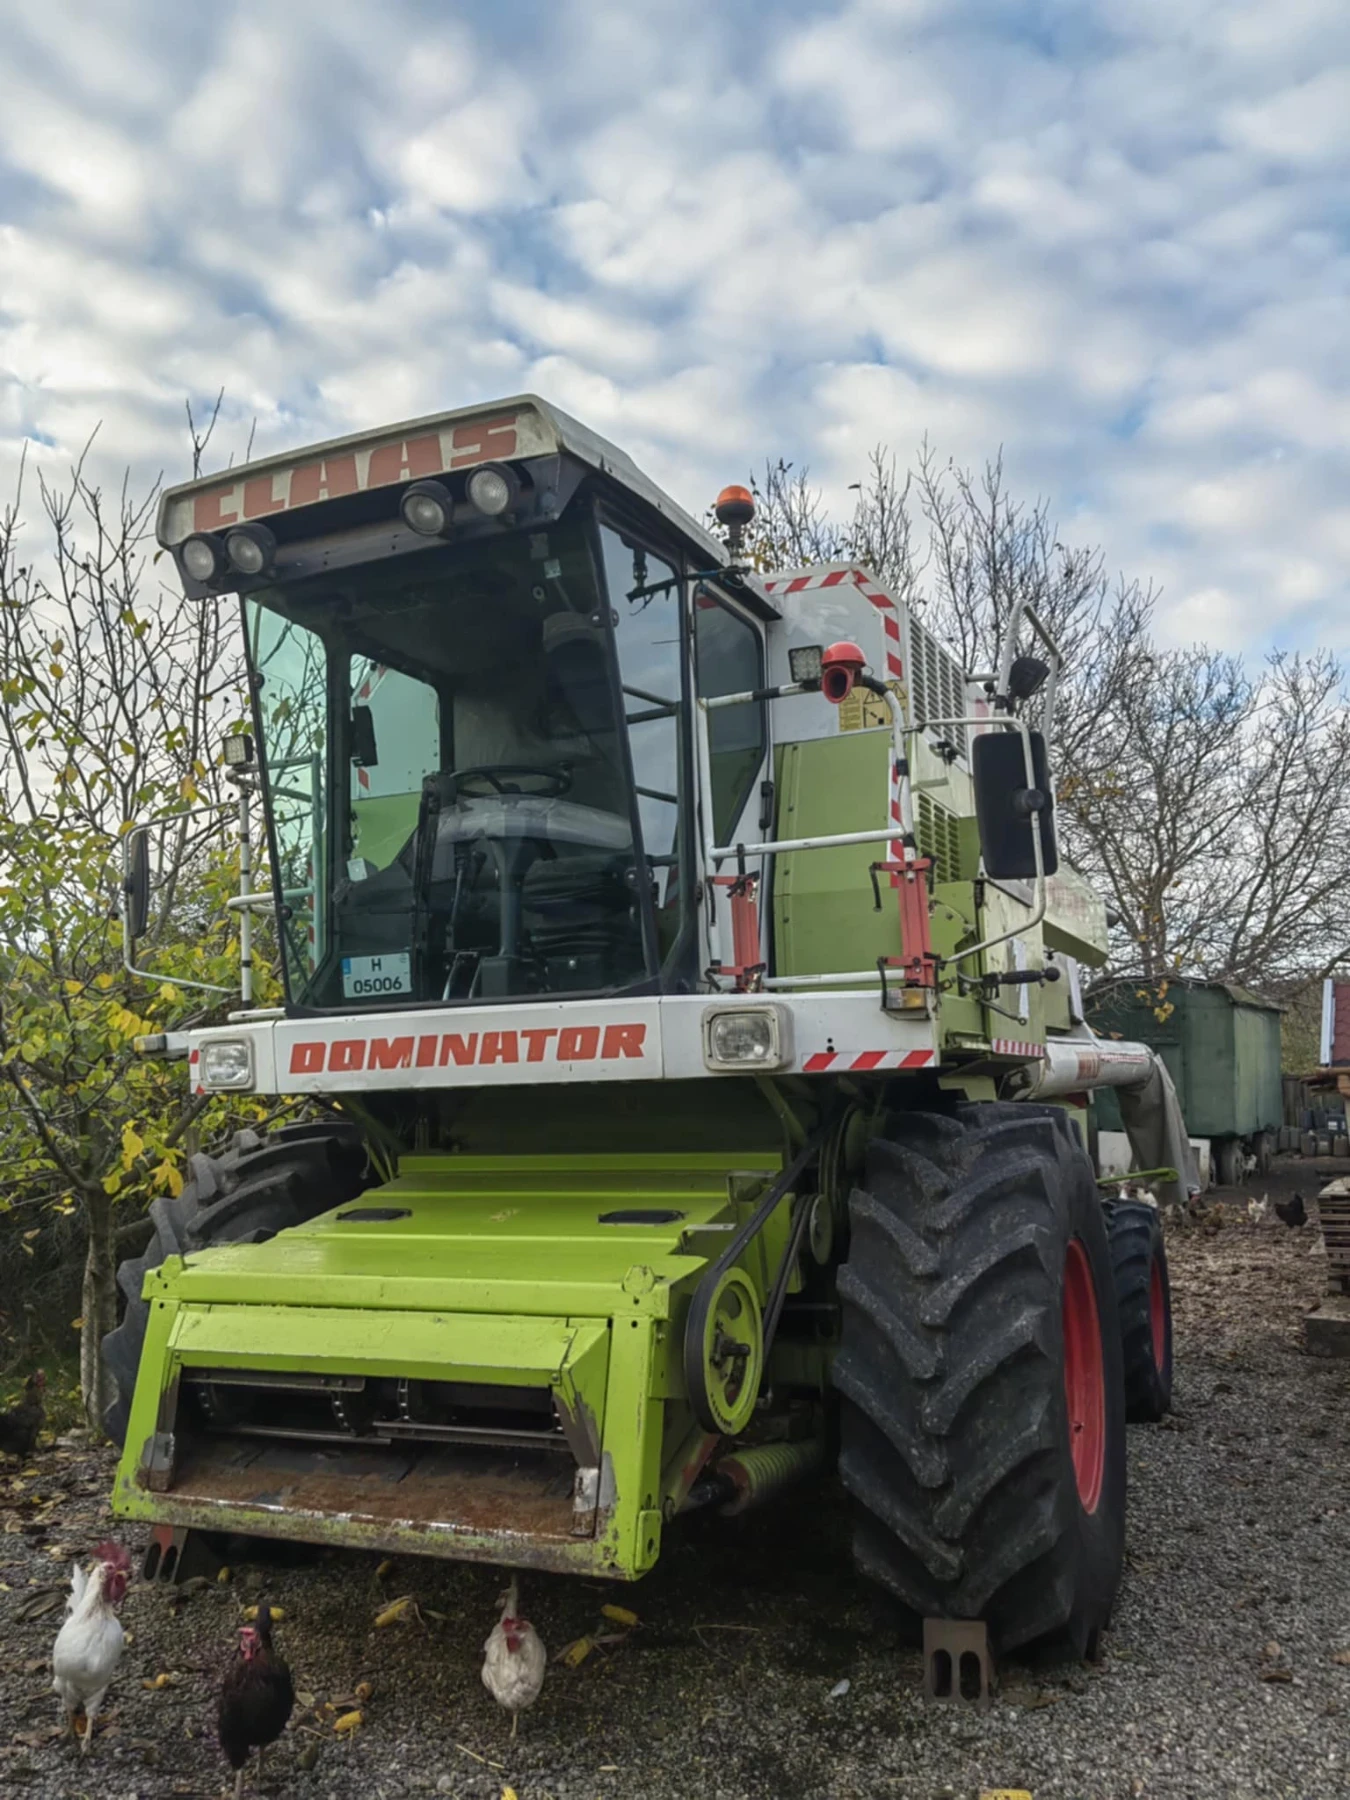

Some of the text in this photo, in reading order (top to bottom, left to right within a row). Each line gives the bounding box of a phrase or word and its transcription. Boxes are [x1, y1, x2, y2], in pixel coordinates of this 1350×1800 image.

[194, 416, 518, 532] CLAAS
[371, 958, 382, 972] H
[353, 976, 402, 994] 05006
[289, 1023, 647, 1074] DOMINATOR
